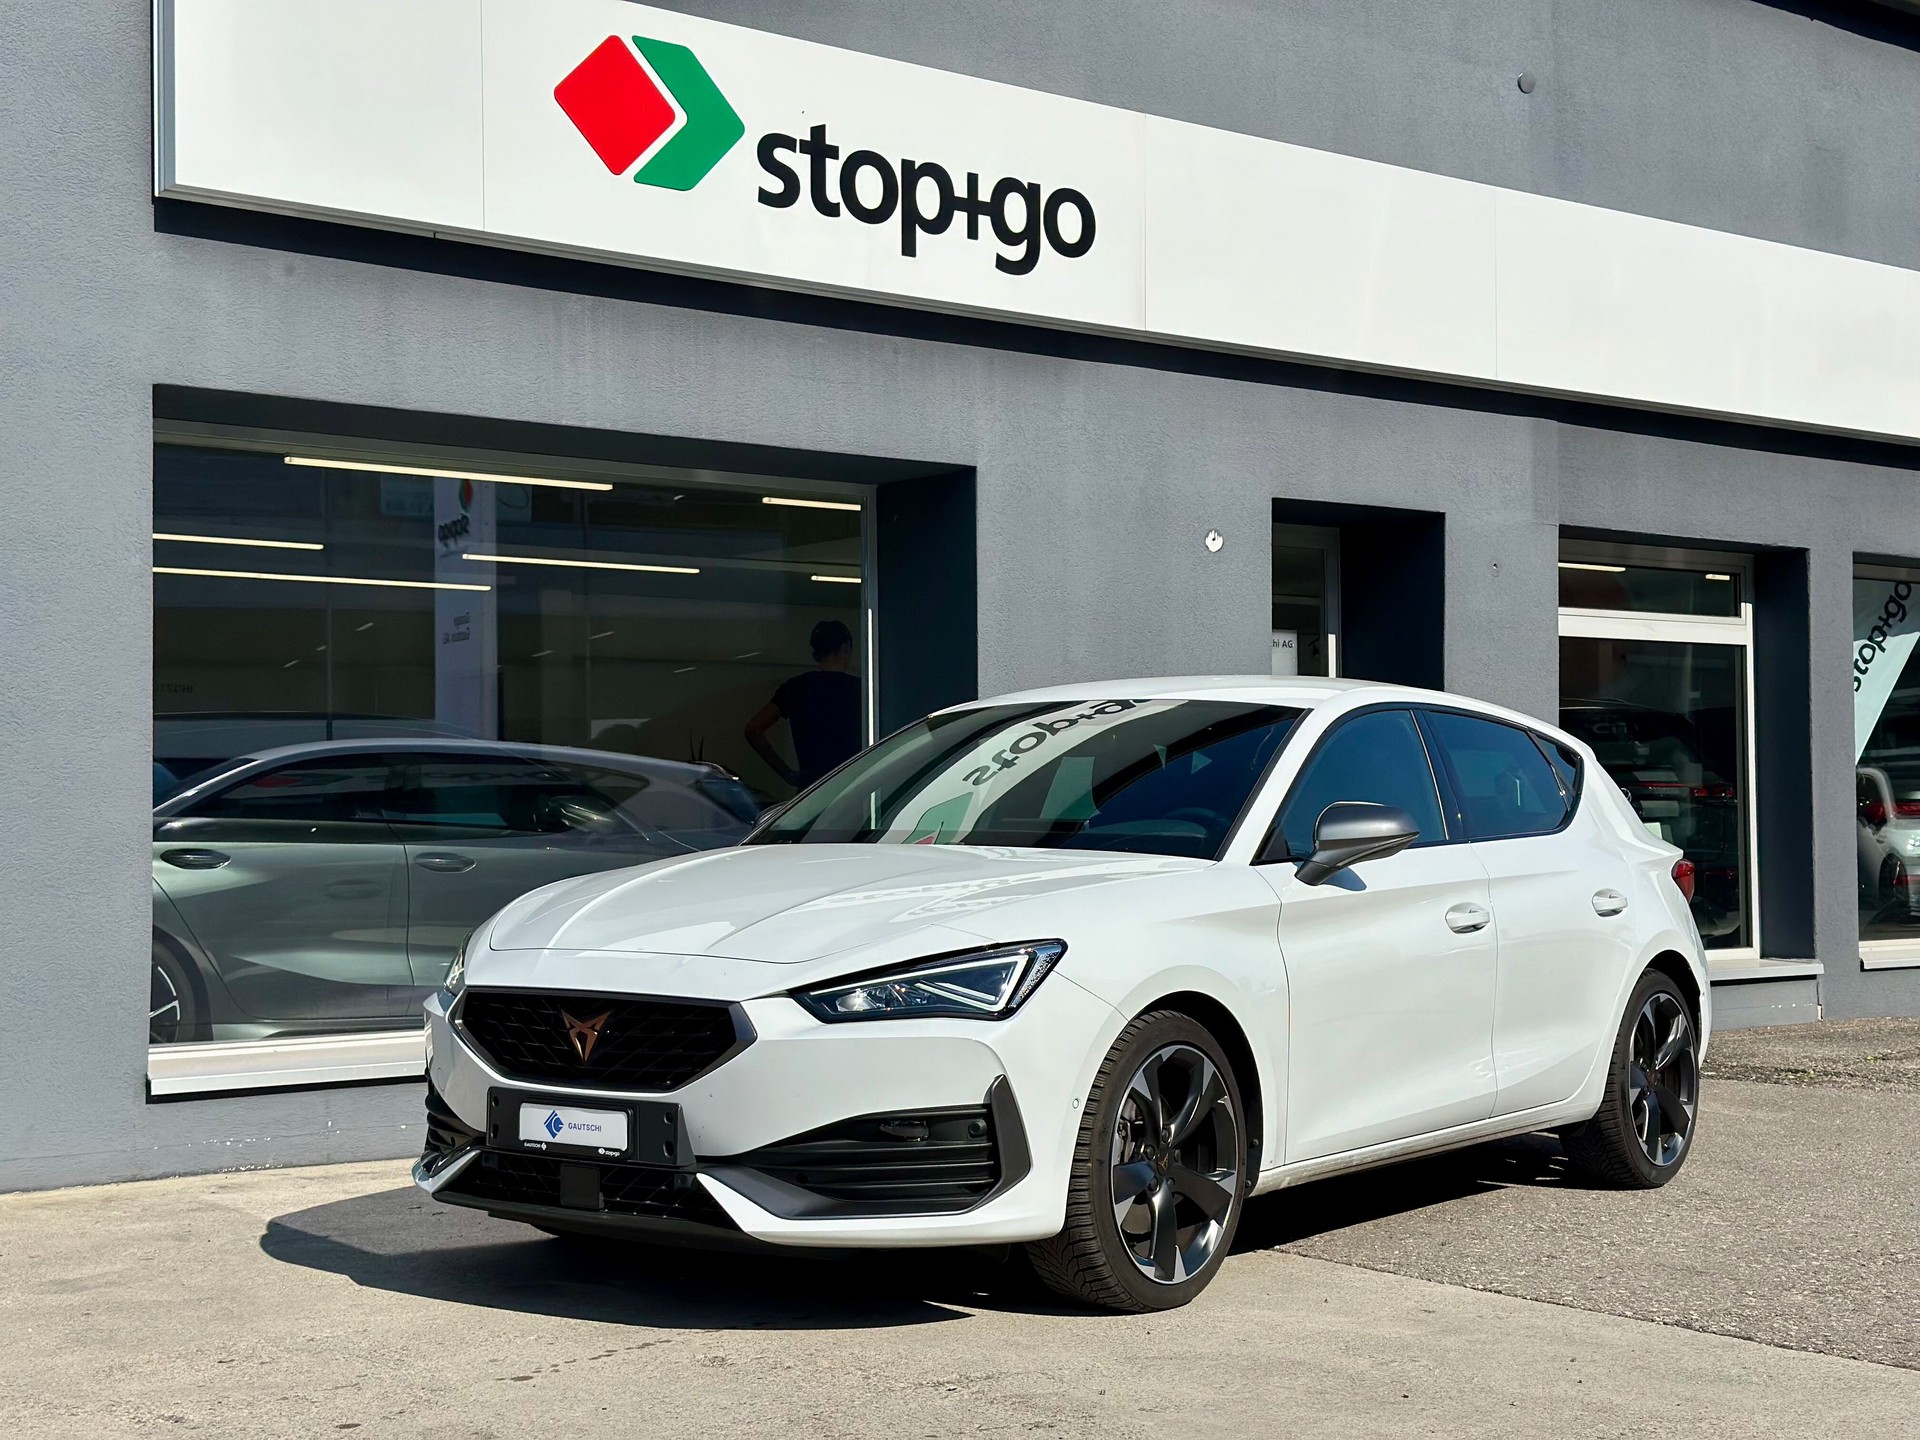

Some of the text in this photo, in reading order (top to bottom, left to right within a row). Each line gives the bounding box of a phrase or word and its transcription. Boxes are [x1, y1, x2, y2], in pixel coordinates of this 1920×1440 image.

[756, 123, 1096, 276] stop+go
[1282, 640, 1293, 648] AG
[568, 1122, 602, 1132] GAUTSCHI
